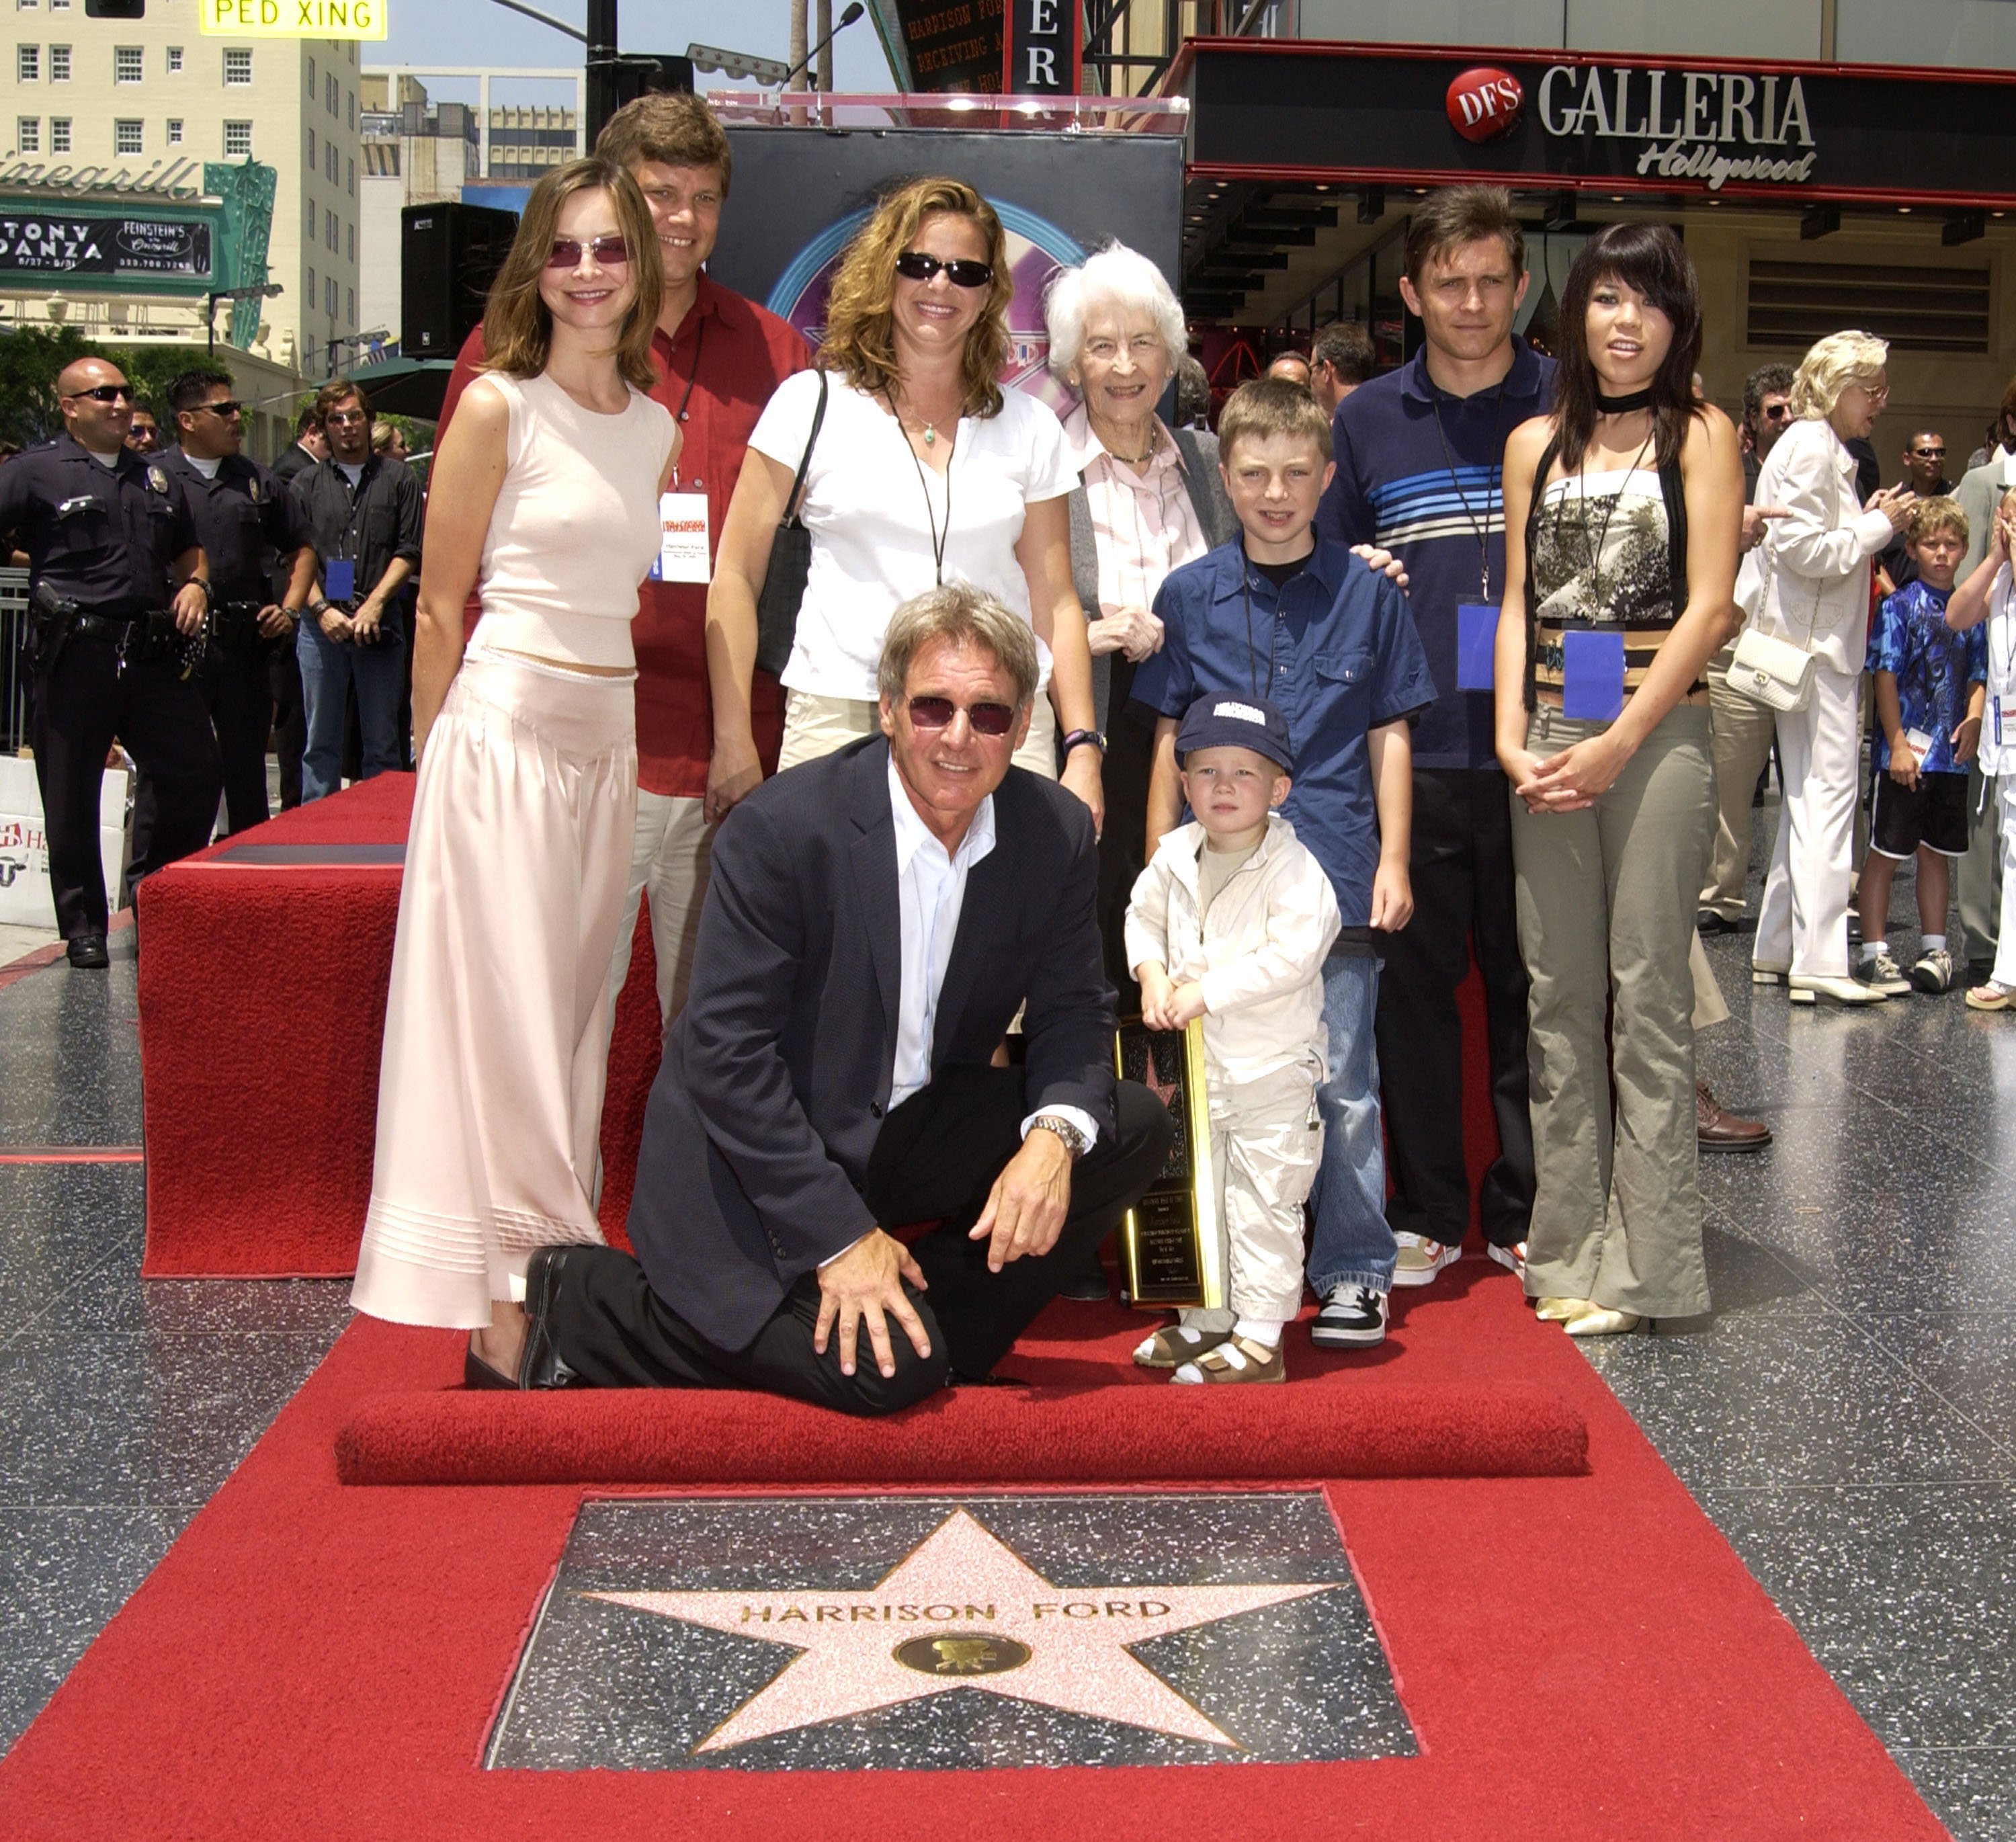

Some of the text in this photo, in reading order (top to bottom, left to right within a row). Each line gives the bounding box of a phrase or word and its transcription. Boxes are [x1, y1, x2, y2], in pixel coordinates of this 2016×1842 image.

[216, 0, 370, 28] PED XING
[1456, 77, 1519, 126] DFS
[1538, 66, 1816, 146] GALLERIA
[1636, 138, 1816, 190] Hollywood
[4, 222, 89, 242] TONY
[124, 221, 185, 239] FEINSTEIN'S
[741, 1601, 1171, 1622] HARRISON FORD
